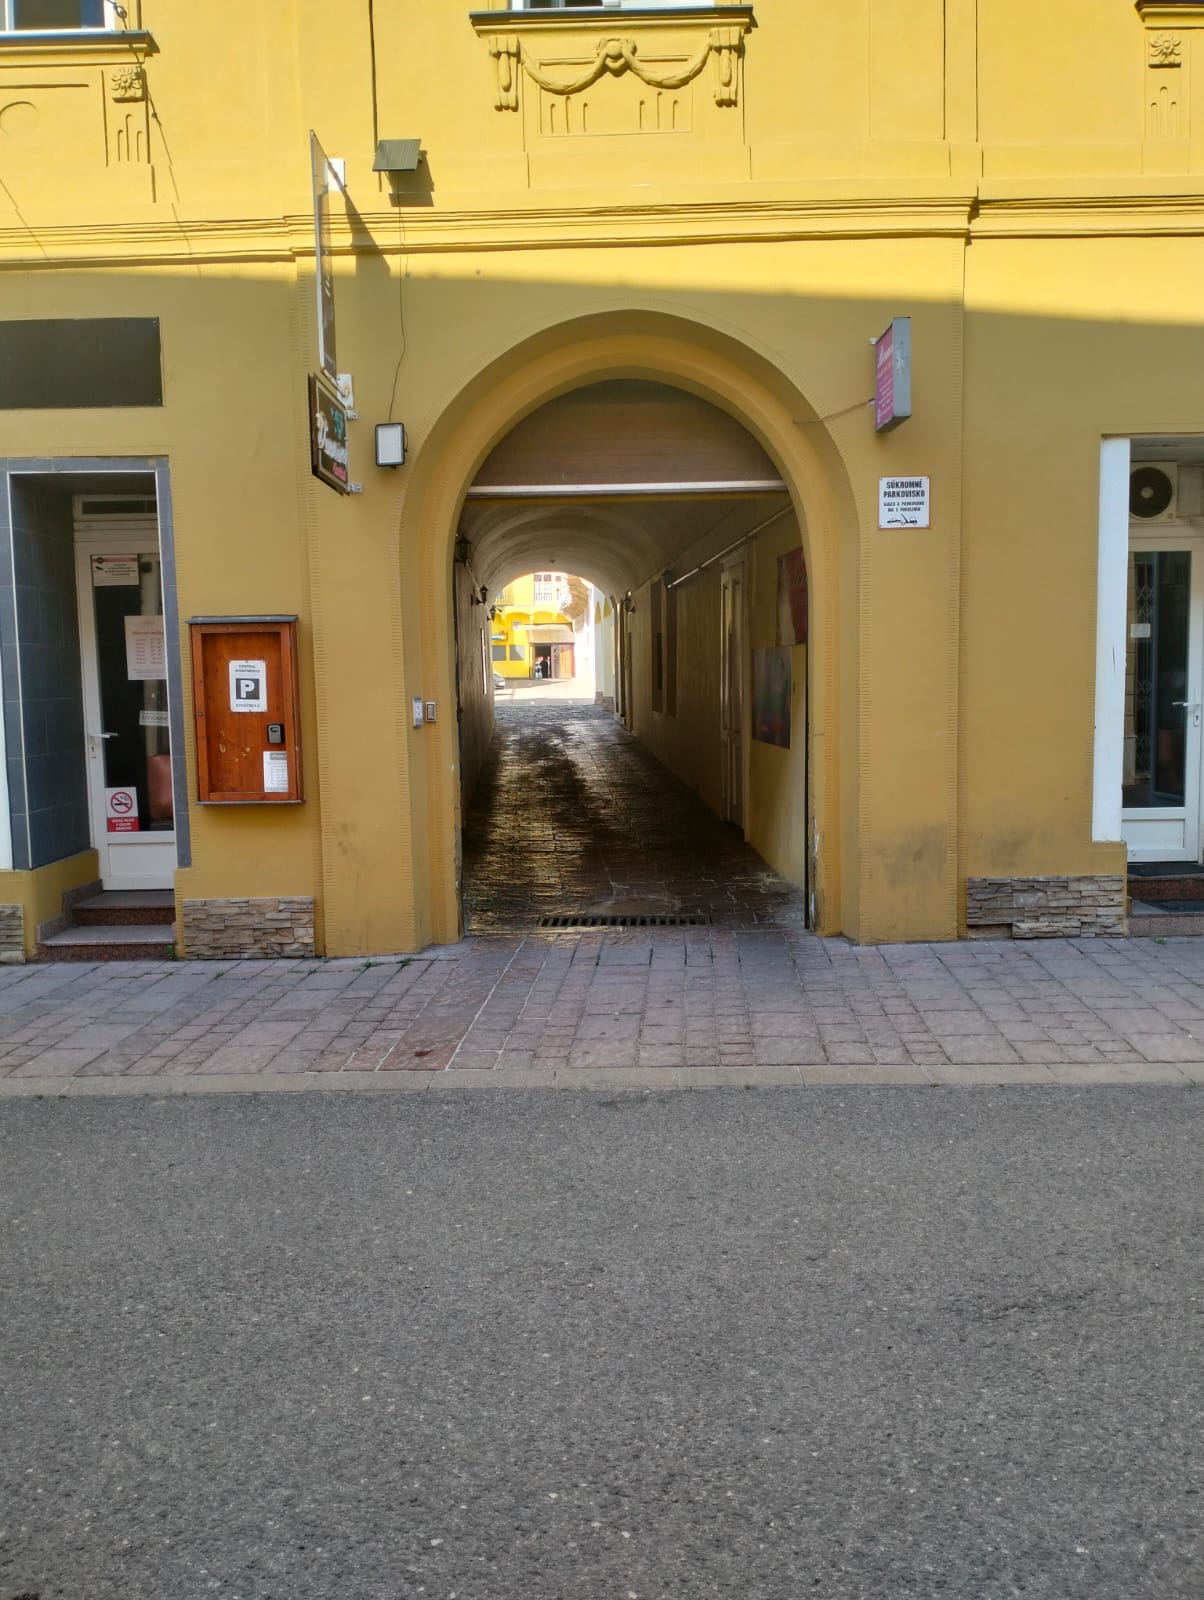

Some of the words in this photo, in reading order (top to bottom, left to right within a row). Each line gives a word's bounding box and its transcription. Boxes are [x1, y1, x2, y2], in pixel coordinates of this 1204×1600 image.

[886, 479, 923, 489] SÚKROMNÉ
[883, 490, 925, 498] PARKOVISKO
[240, 679, 255, 699] P
